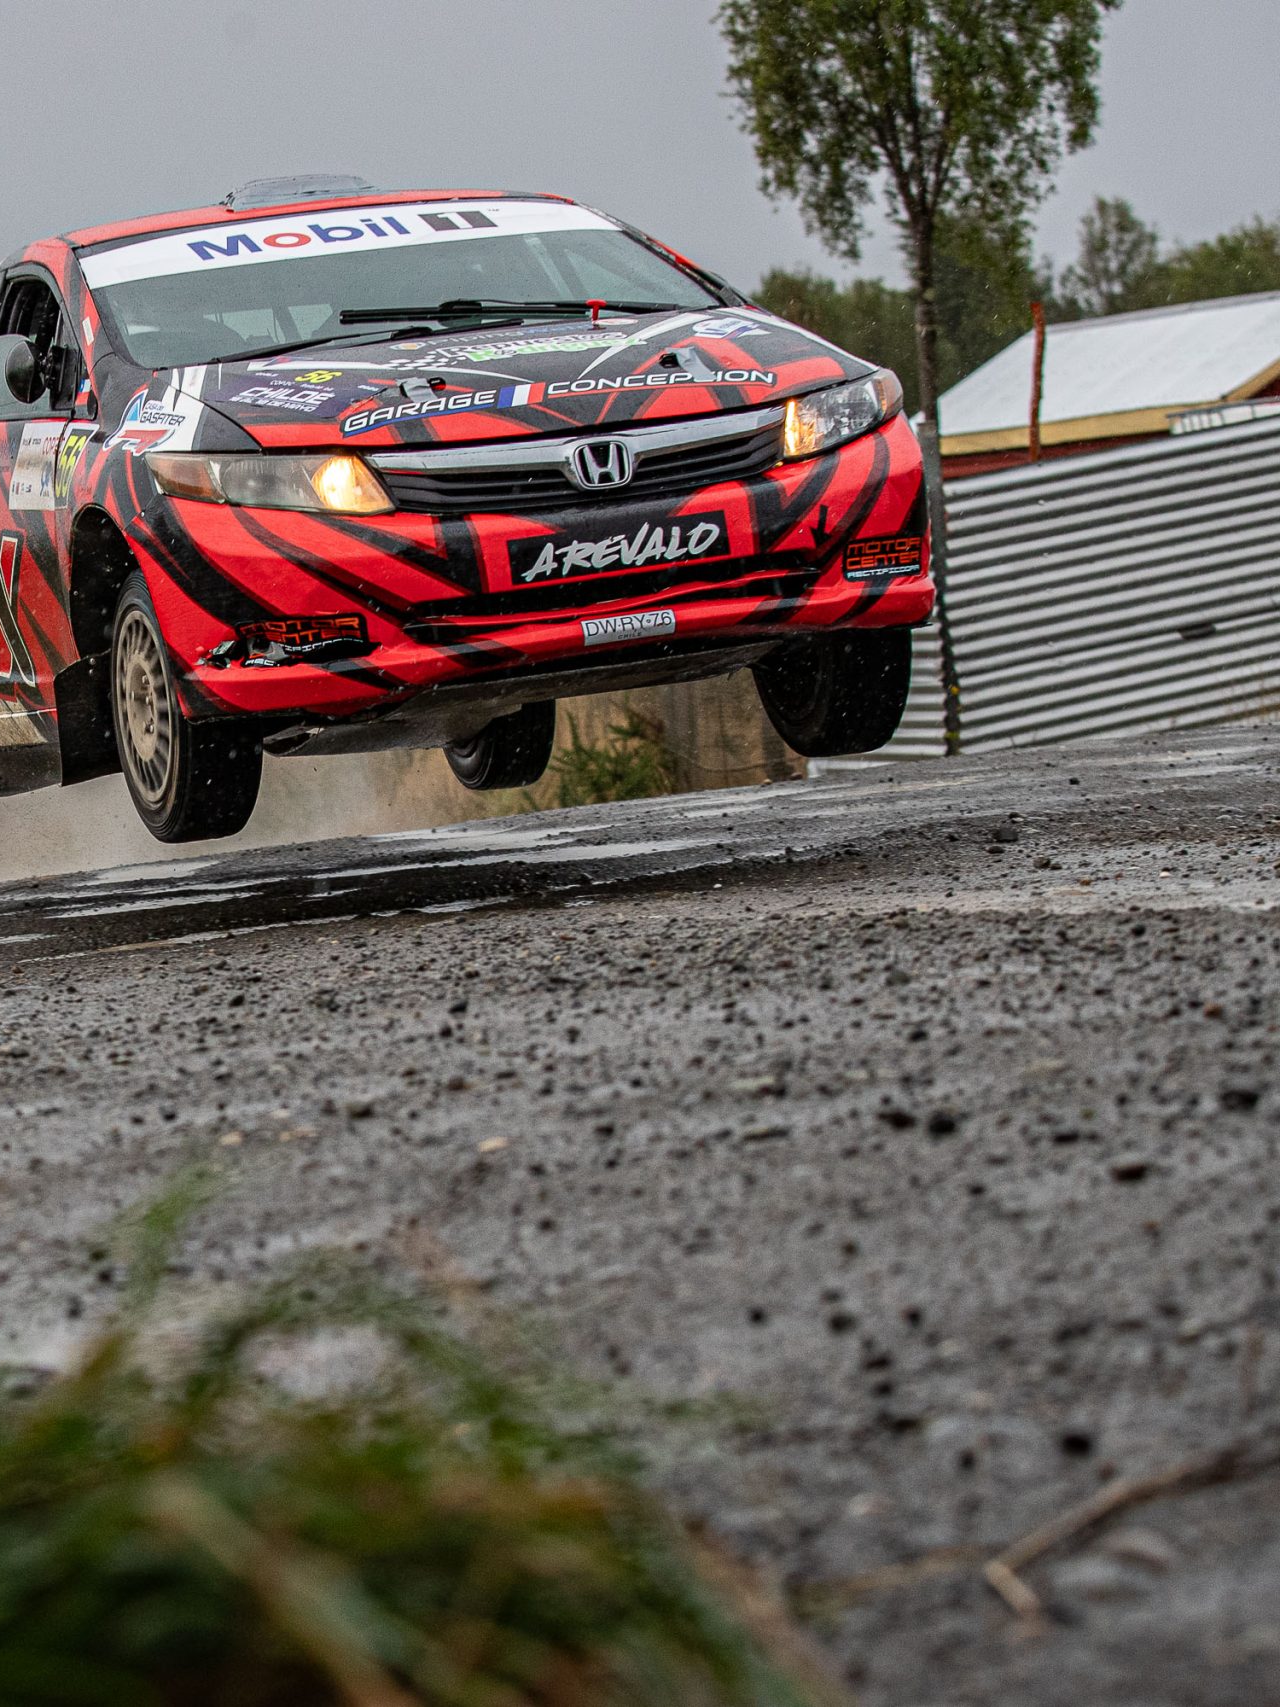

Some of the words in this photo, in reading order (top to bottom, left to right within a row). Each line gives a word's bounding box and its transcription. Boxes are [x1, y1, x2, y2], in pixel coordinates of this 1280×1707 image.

[187, 215, 412, 261] Mobil
[294, 369, 344, 384] 56
[344, 389, 497, 432] GARAGE
[521, 522, 720, 582] AREVALO
[847, 537, 921, 556] MOTOR
[846, 551, 920, 570] CENTER
[240, 616, 360, 634] MOTOR
